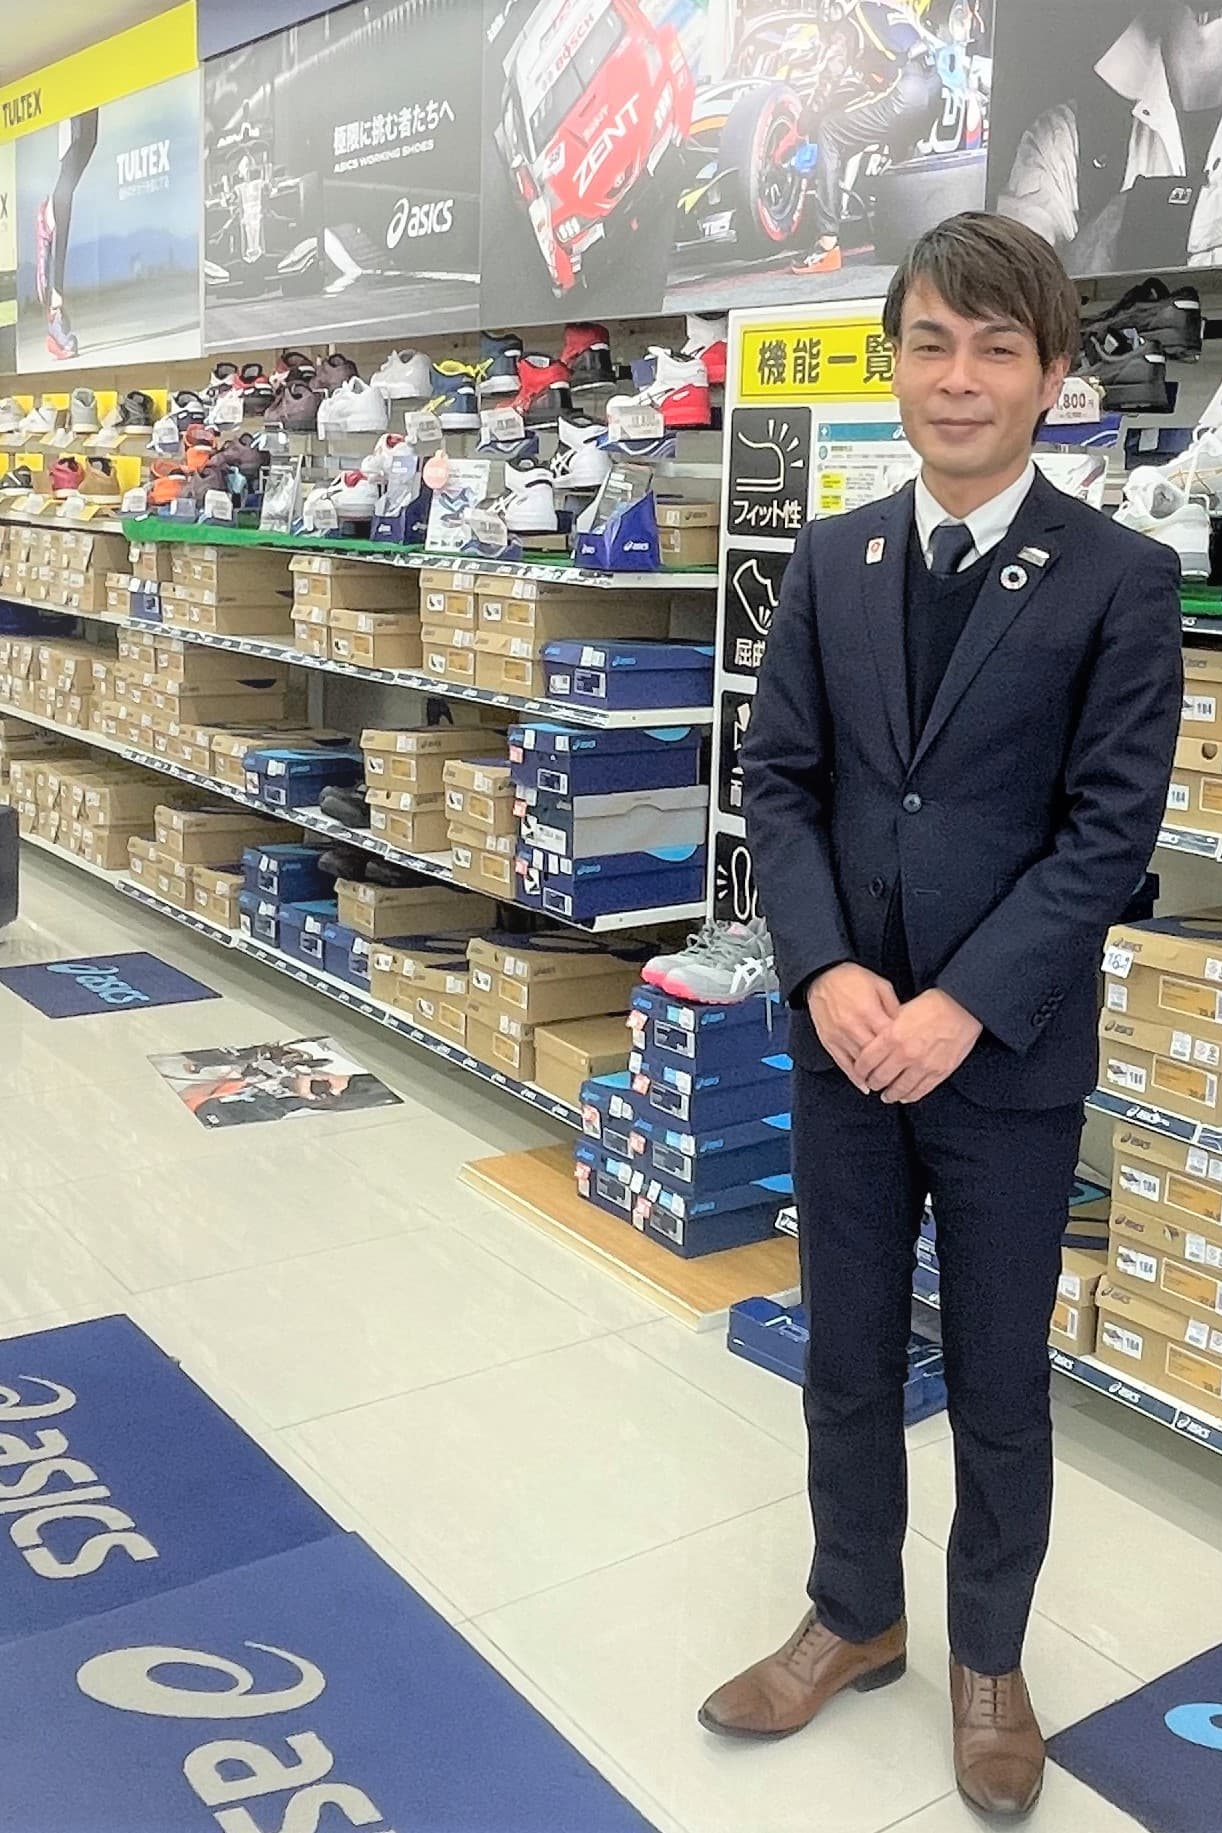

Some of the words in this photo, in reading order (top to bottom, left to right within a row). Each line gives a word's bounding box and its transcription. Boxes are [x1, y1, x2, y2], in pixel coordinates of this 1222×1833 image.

[2, 88, 42, 128] TULTEX
[334, 99, 455, 156] 極限に挑む者たちへ
[117, 139, 170, 185] TULTEX
[572, 93, 640, 198] ZENT
[407, 199, 454, 238] asics
[758, 334, 894, 385] 機能一覧
[732, 500, 802, 529] フィット性
